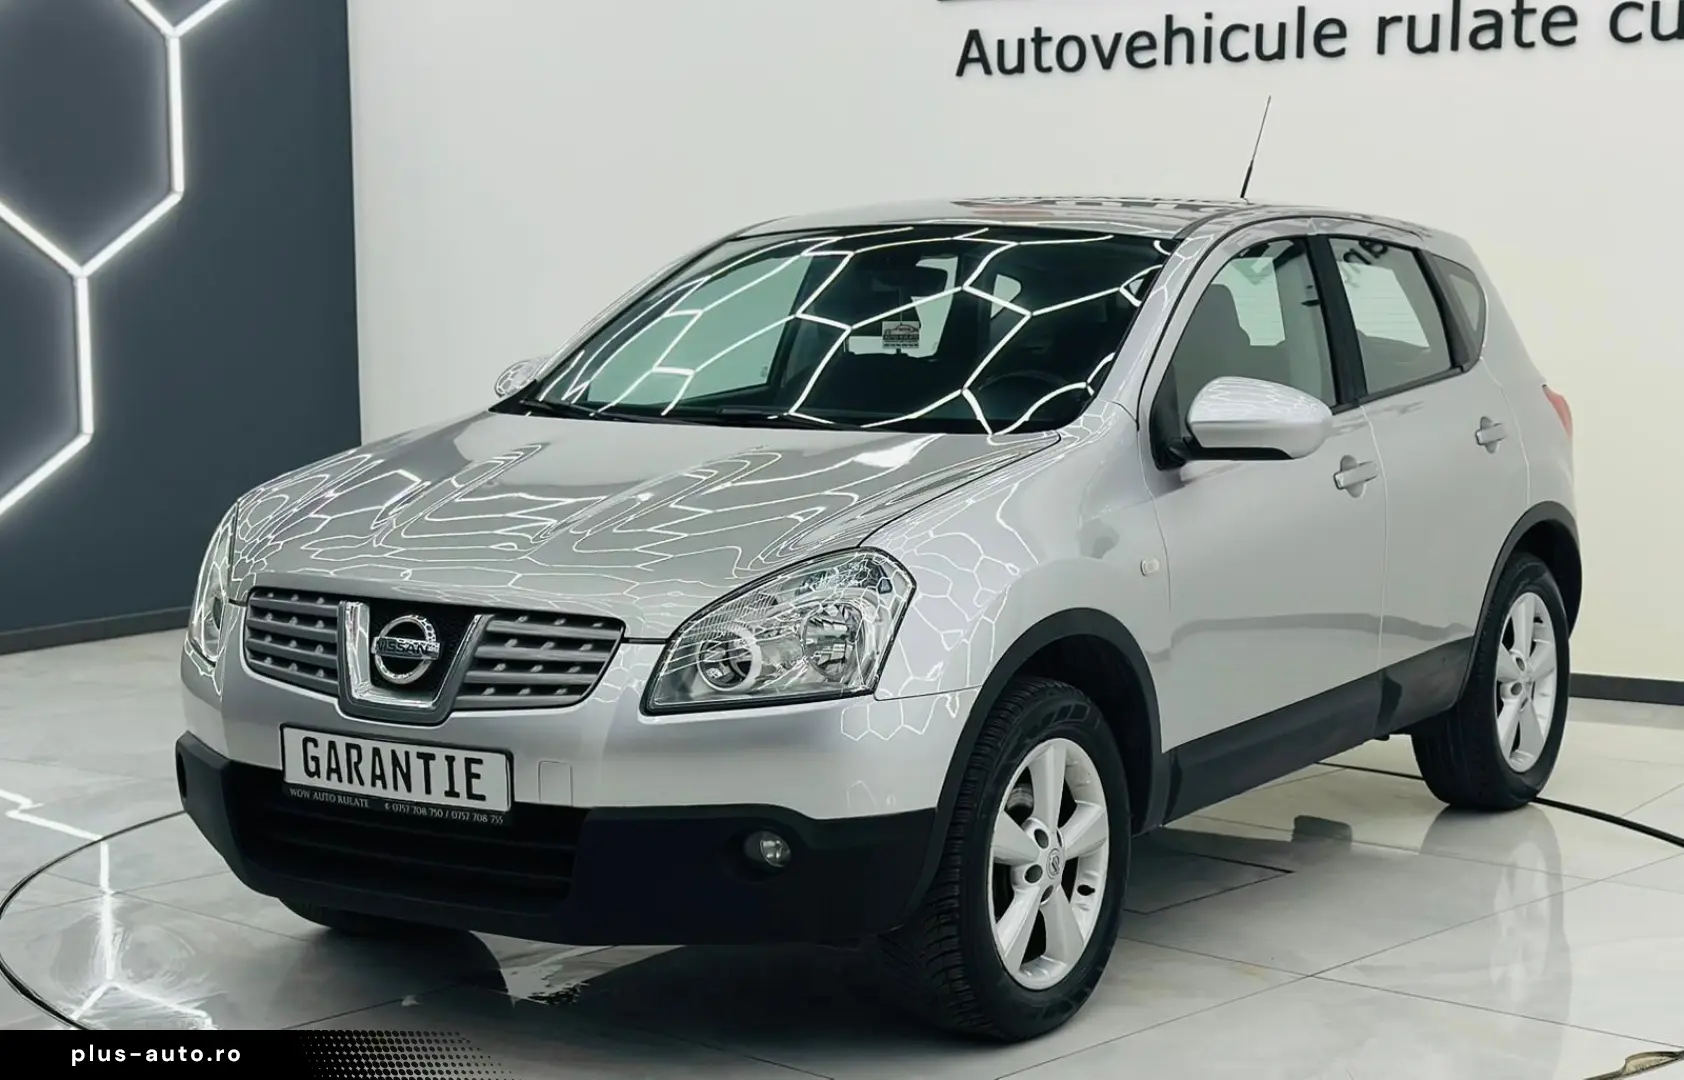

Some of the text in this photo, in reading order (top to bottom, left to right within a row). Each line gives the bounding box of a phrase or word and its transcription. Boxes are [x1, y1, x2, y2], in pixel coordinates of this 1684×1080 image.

[956, 6, 1348, 78] Autovehicule
[1376, 0, 1580, 56] rulate
[376, 638, 430, 654] NISSAN
[302, 736, 487, 802] GARANTIE
[289, 788, 369, 808] WOW AUTO RULATE
[392, 803, 410, 812] 0757
[413, 806, 427, 816] 708
[451, 811, 469, 821] 0757
[472, 813, 488, 823] 708
